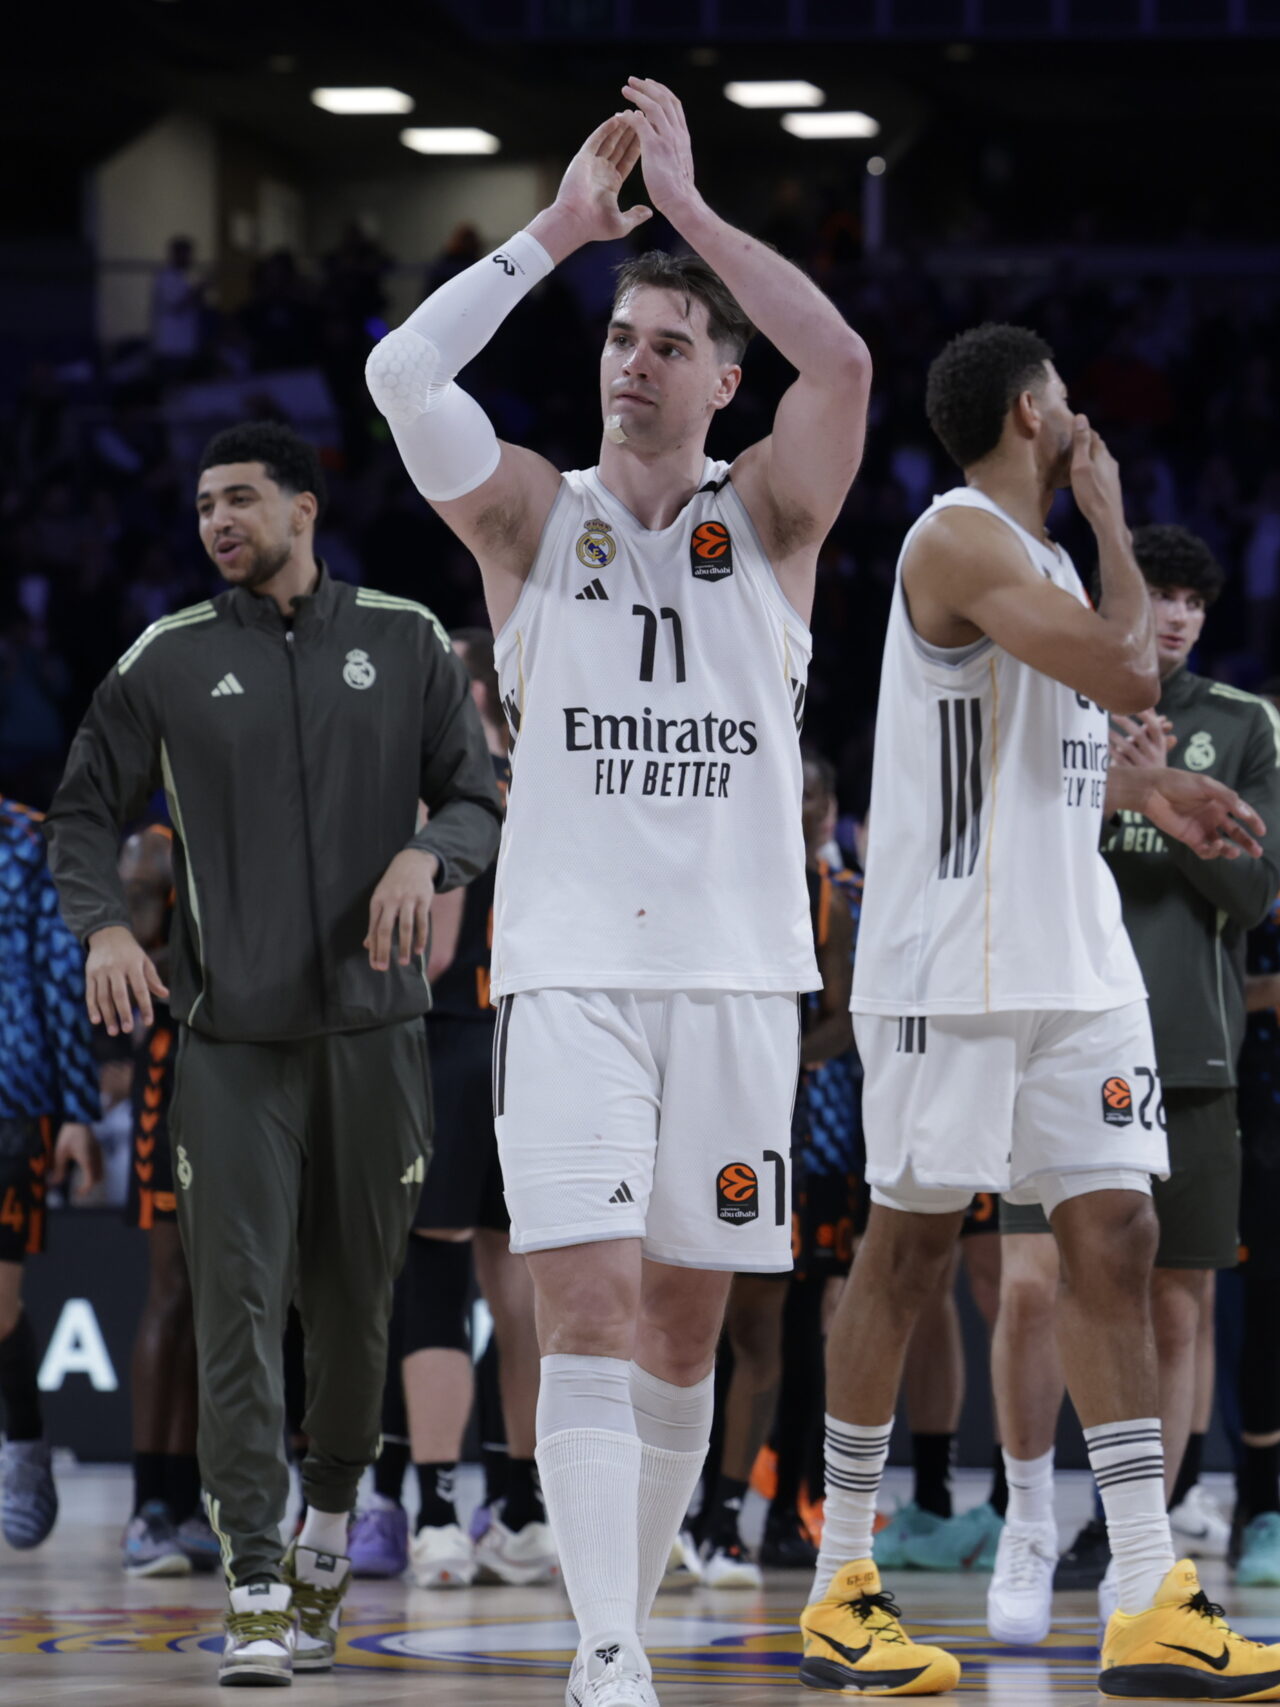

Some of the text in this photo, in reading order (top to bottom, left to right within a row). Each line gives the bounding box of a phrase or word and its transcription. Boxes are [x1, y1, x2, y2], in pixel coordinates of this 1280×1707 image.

[632, 604, 686, 683] 11
[562, 706, 758, 756] Emirates
[595, 758, 731, 798] FLY BETTER
[720, 1210, 734, 1218] abu
[735, 1209, 756, 1218] dhabi
[36, 1297, 119, 1392] A
